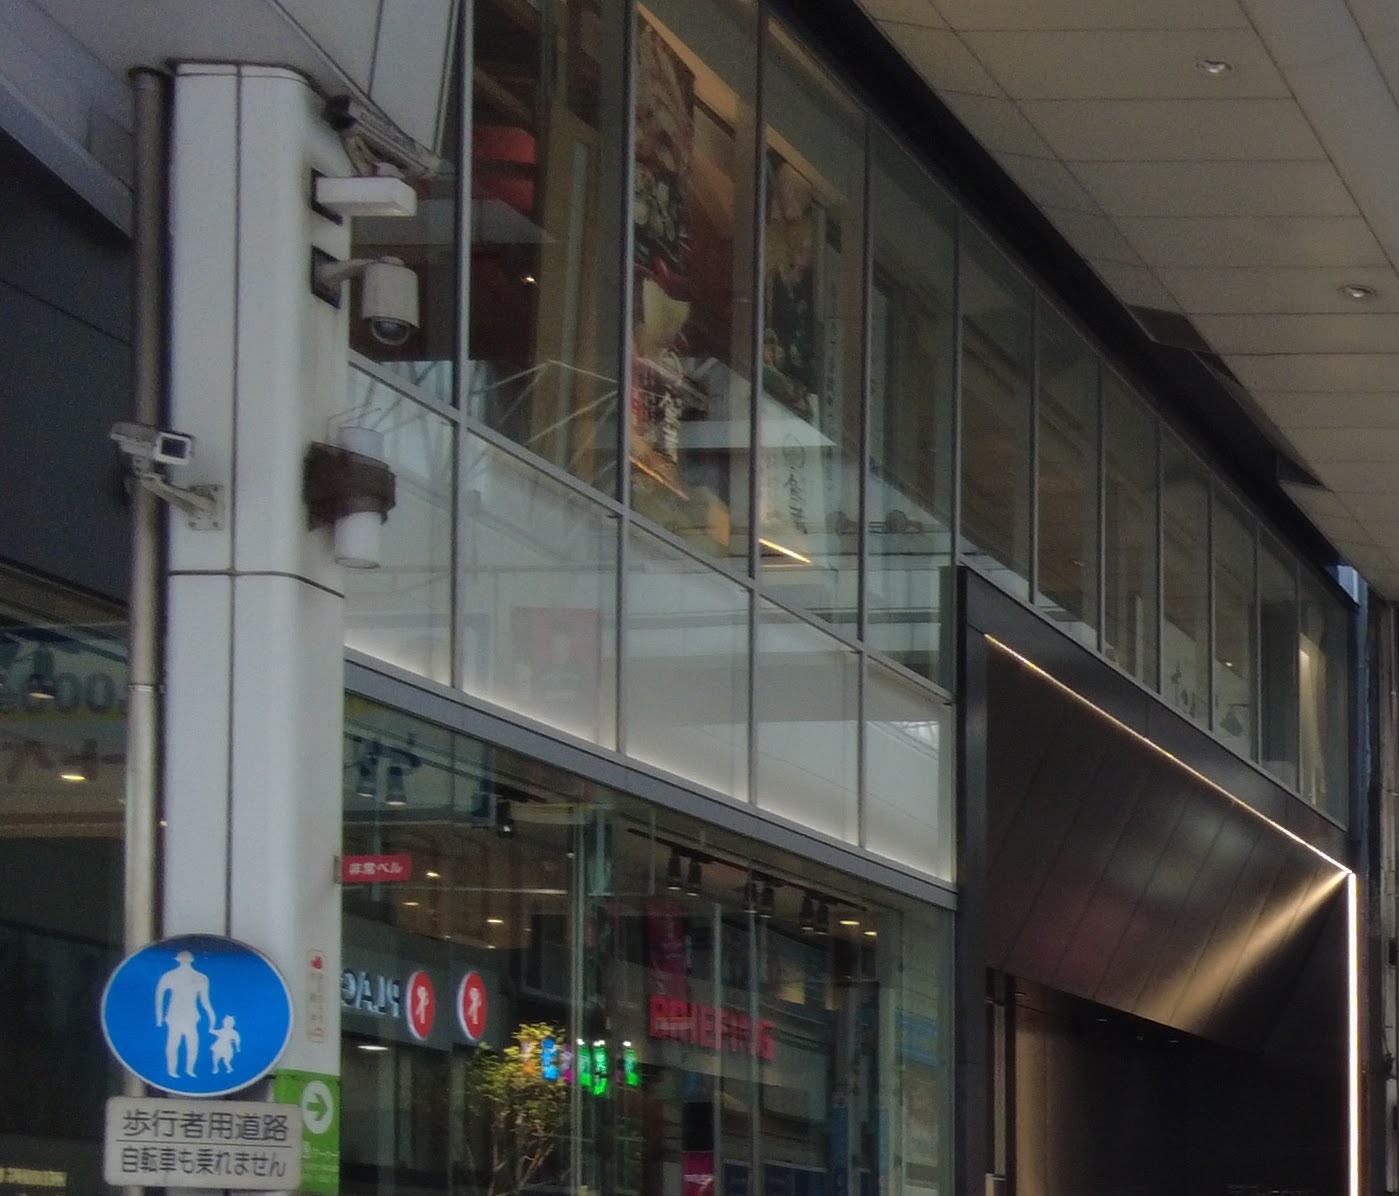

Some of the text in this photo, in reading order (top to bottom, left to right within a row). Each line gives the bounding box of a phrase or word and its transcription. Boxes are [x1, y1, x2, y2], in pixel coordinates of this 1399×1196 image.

[122, 1108, 289, 1143] 歩行者用道路
[120, 1146, 287, 1179] 自転車も乗れません
